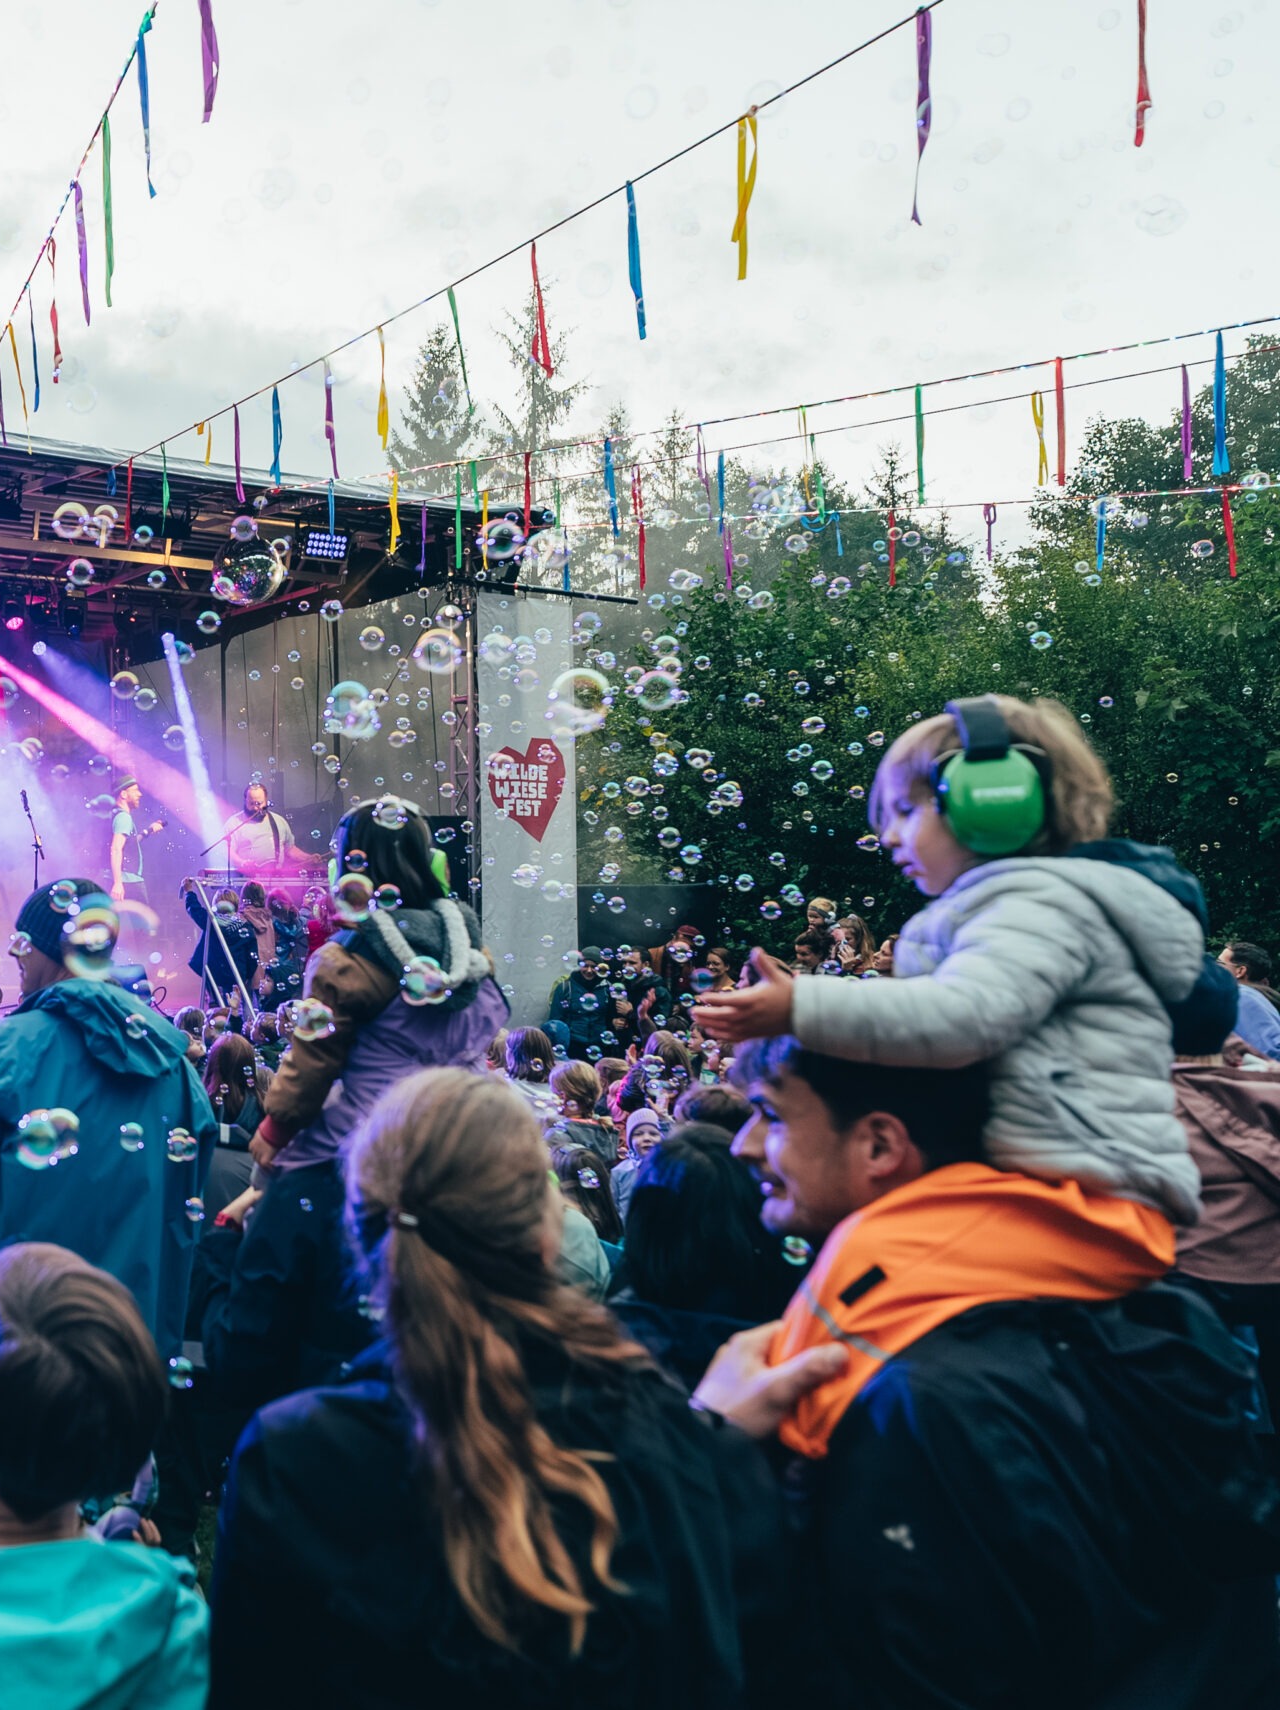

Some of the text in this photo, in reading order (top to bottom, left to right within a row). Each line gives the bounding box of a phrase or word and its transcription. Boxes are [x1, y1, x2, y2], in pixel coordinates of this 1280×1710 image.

[492, 762, 549, 781] WILDE
[495, 781, 548, 799] WIESE
[503, 799, 542, 817] FEST
